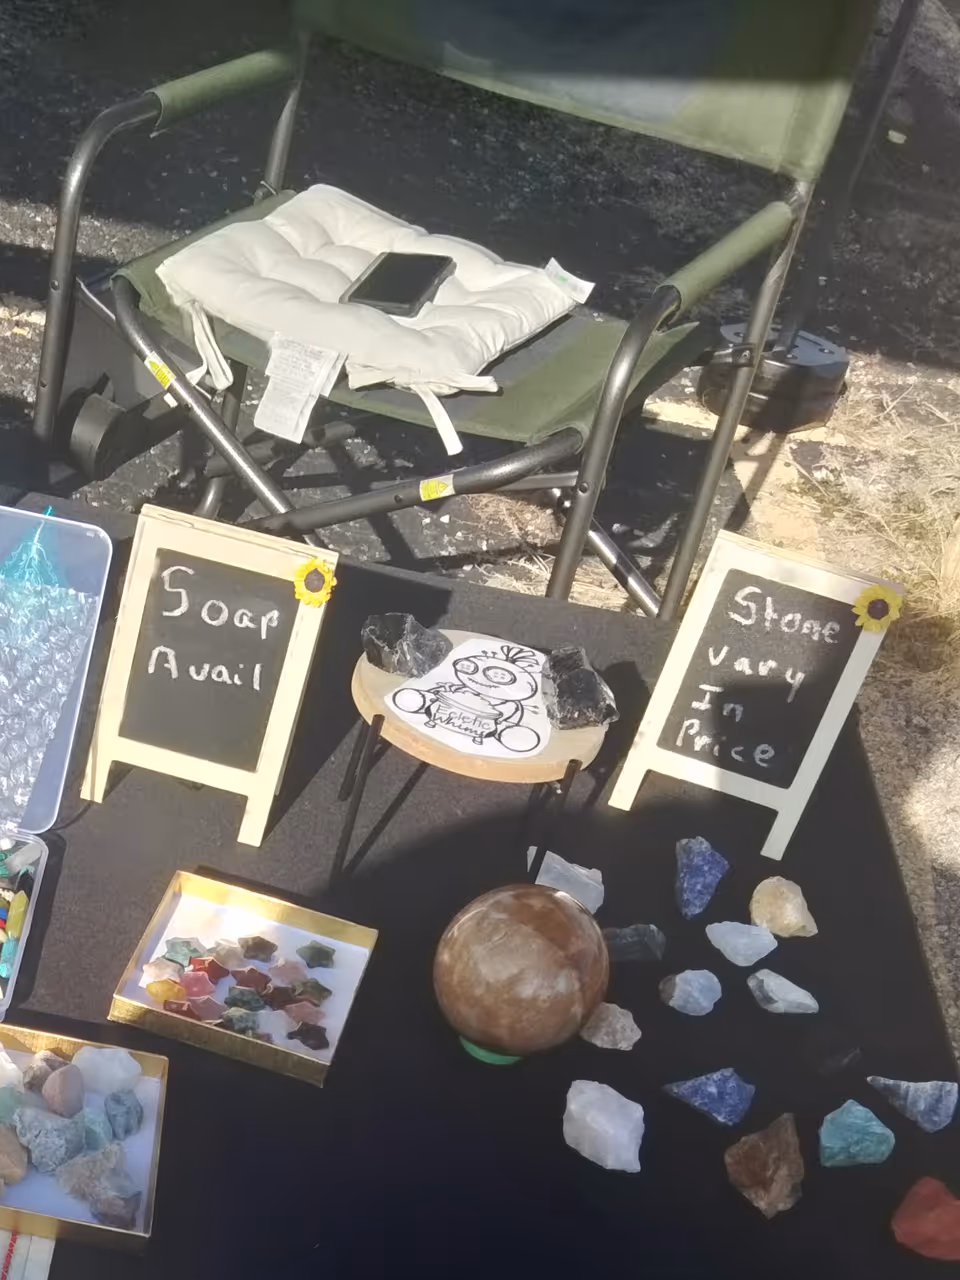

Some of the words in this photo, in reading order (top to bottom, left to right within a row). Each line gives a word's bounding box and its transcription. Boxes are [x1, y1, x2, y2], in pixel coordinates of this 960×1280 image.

[161, 566, 280, 640] Soap
[728, 586, 840, 644] Stone
[147, 646, 263, 691] Avail
